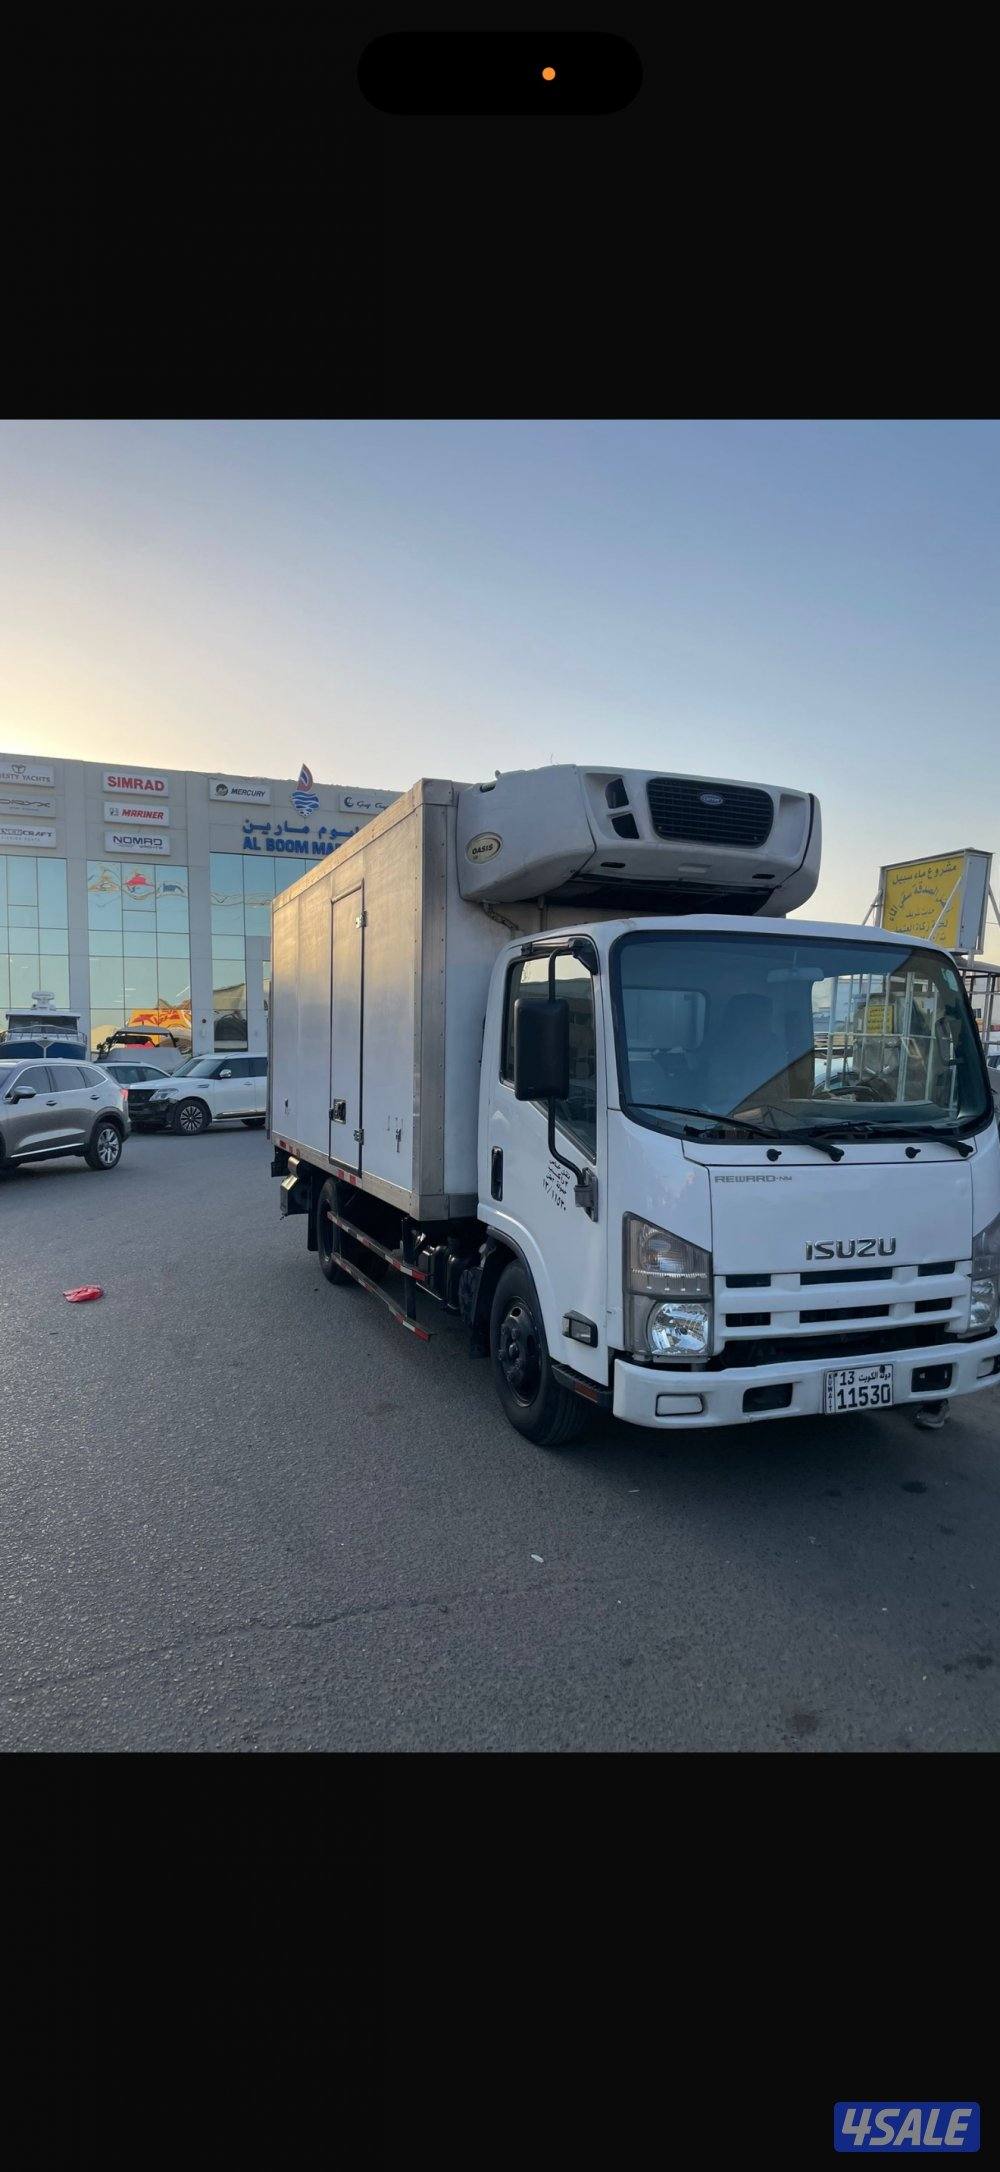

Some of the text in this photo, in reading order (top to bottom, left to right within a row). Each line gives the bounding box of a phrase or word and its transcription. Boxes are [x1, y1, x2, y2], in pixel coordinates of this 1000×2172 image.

[22, 775, 50, 783] YACHTS
[107, 776, 165, 791] SIMRAD
[231, 787, 266, 797] MERCURY
[121, 809, 165, 820] MARINER
[242, 818, 310, 836] مارين
[113, 835, 163, 846] NOMAD
[243, 836, 261, 850] AL
[265, 838, 309, 854] BOOM
[472, 844, 494, 855] OASIS
[805, 1236, 897, 1261] ISUZU
[839, 1371, 855, 1387] 13
[858, 1370, 879, 1384] الكويت
[837, 1383, 892, 1410] 11530
